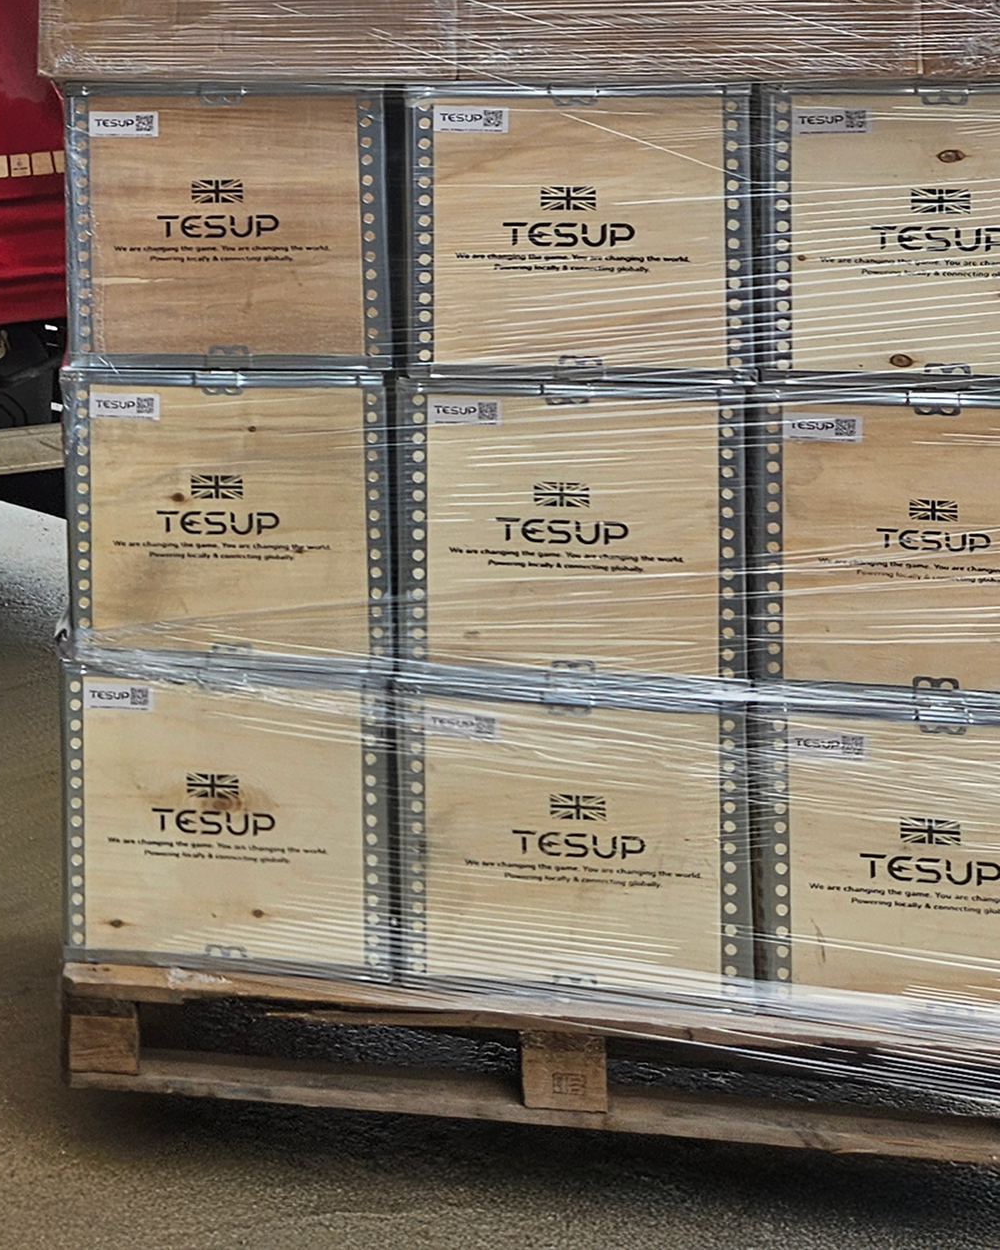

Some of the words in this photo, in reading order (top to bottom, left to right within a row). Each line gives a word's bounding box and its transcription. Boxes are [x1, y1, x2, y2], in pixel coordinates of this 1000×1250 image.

[94, 118, 135, 128] TESUP
[439, 112, 483, 123] TESUP
[797, 114, 844, 125] TESUP
[156, 214, 280, 238] TESUP
[502, 222, 636, 247] TESUP
[870, 226, 1000, 252] TESUP
[94, 399, 136, 410] TESUP
[433, 404, 477, 416] TESUP
[156, 510, 280, 535] TESUP
[495, 517, 629, 545] TESUP
[876, 527, 991, 552] TESUP
[89, 689, 130, 700] TESUP
[151, 807, 275, 836] TESUP
[511, 829, 646, 859] TESUP
[859, 853, 1000, 886] TESUP
[808, 882, 824, 890] We
[842, 885, 886, 896] changing
[887, 888, 902, 896] the
[934, 891, 952, 900] You
[850, 896, 892, 908] Powering
[894, 900, 922, 909] locally
[934, 904, 982, 914] connecting
